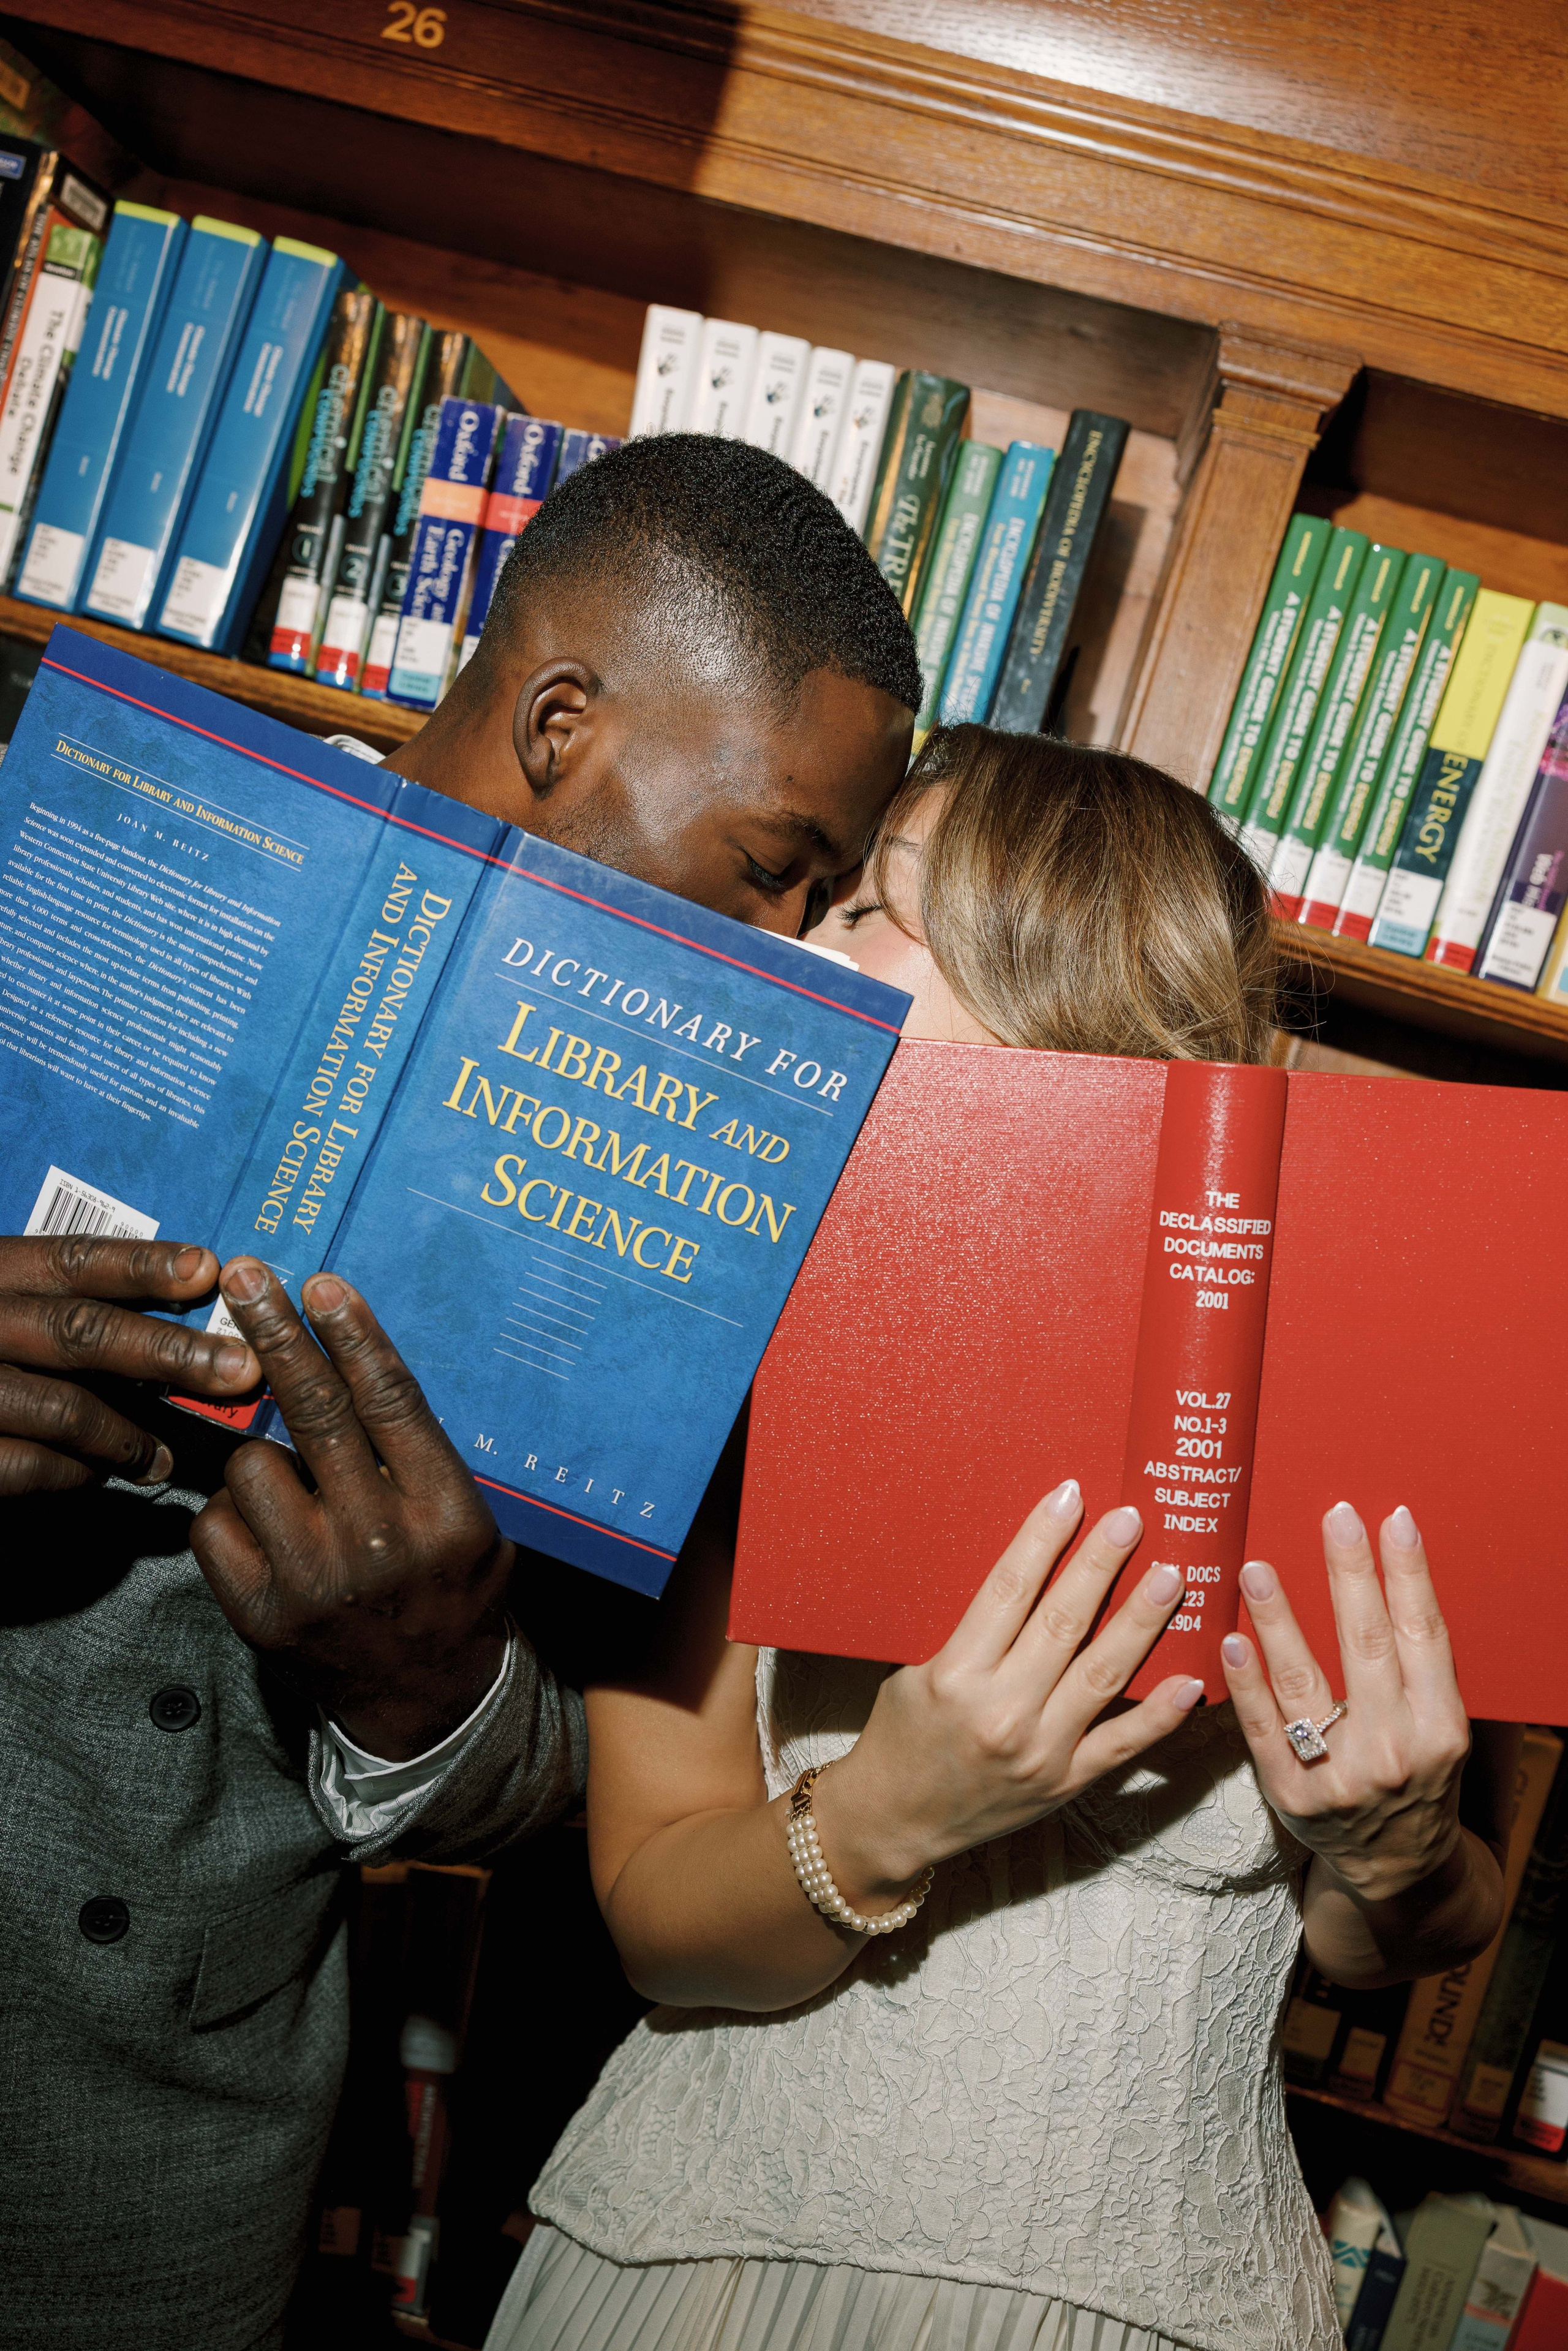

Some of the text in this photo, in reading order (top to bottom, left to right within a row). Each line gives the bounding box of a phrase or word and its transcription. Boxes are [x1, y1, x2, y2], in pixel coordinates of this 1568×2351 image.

[380, 1, 446, 48] 26
[43, 310, 65, 341] The
[2, 357, 32, 417] Debate
[26, 343, 54, 409] Climate
[7, 412, 36, 476] Change
[315, 364, 356, 483] chemical
[364, 385, 404, 504] chemical
[448, 409, 479, 481] Oxford
[512, 422, 544, 494] Oxford
[890, 492, 924, 536] The
[1028, 429, 1102, 657] ENCYCLOPEDIA OF BIODIVERSITY
[420, 525, 443, 573] Earth
[429, 528, 464, 623] Geology an
[944, 512, 979, 595] ENCYCLOPEDIA
[990, 517, 1024, 600] ENCYCLOPEDIA
[940, 597, 956, 614] OF
[986, 603, 1000, 620] OF
[1224, 592, 1300, 804] A STUDENT GUIDE TO ENERGY
[1265, 605, 1341, 818] A STUDENT GUIDE TO ENERGY
[1303, 618, 1381, 829] A STUDENT GUIDE TO ENERGY
[1340, 628, 1420, 840] A STUDENT GUIDE TO ENERGY
[1376, 646, 1455, 856] A STUDENT GUIDE TO ENERGY
[116, 813, 209, 861] JOAN M. REITZ
[1415, 752, 1468, 862] ENERGY
[23, 816, 47, 831] Science
[47, 828, 59, 837] was
[59, 834, 74, 845] soon
[74, 842, 105, 859] expanded
[104, 856, 118, 866] and
[116, 862, 148, 881] converted
[156, 880, 187, 899] electronic
[187, 894, 209, 910] format
[208, 904, 219, 915] for
[218, 909, 254, 932] installation
[253, 927, 263, 936] on
[263, 931, 275, 942] the
[29, 801, 58, 822] Beginning
[58, 816, 66, 825] in
[66, 820, 82, 832] 1994
[94, 833, 120, 850] five-page
[120, 845, 146, 864] handout,
[147, 859, 158, 868] the
[157, 864, 192, 885] Dictionary
[190, 880, 203, 889] for
[202, 885, 228, 902] Library
[227, 898, 243, 908] and
[241, 903, 281, 927] Information
[500, 937, 847, 1101] DICTIONARY FOR
[497, 1000, 790, 1163] LIBRARY AND
[442, 1055, 797, 1243] INFORMATION
[59, 1178, 116, 1213] ISBN 1-56308-962-9
[480, 1153, 700, 1283] SCIENCE
[1159, 1210, 1272, 1236] DECLASSIFIED
[1204, 1188, 1240, 1209] THE
[120, 1221, 144, 1237] 90000
[1163, 1236, 1264, 1259] DOCUMENTS
[1169, 1262, 1255, 1285] CATALOG:
[1195, 1289, 1228, 1310] 2001
[1174, 1414, 1227, 1434] NO.1-3
[1175, 1389, 1231, 1409] VOL.27
[473, 1433, 655, 1518] M. REITZ
[1143, 1460, 1242, 1484] ABSTRACT/
[1175, 1436, 1222, 1459] 2001
[1154, 1487, 1231, 1508] SUBJECT
[1163, 1513, 1218, 1533] INDEX
[1186, 1565, 1221, 1583] DOCS
